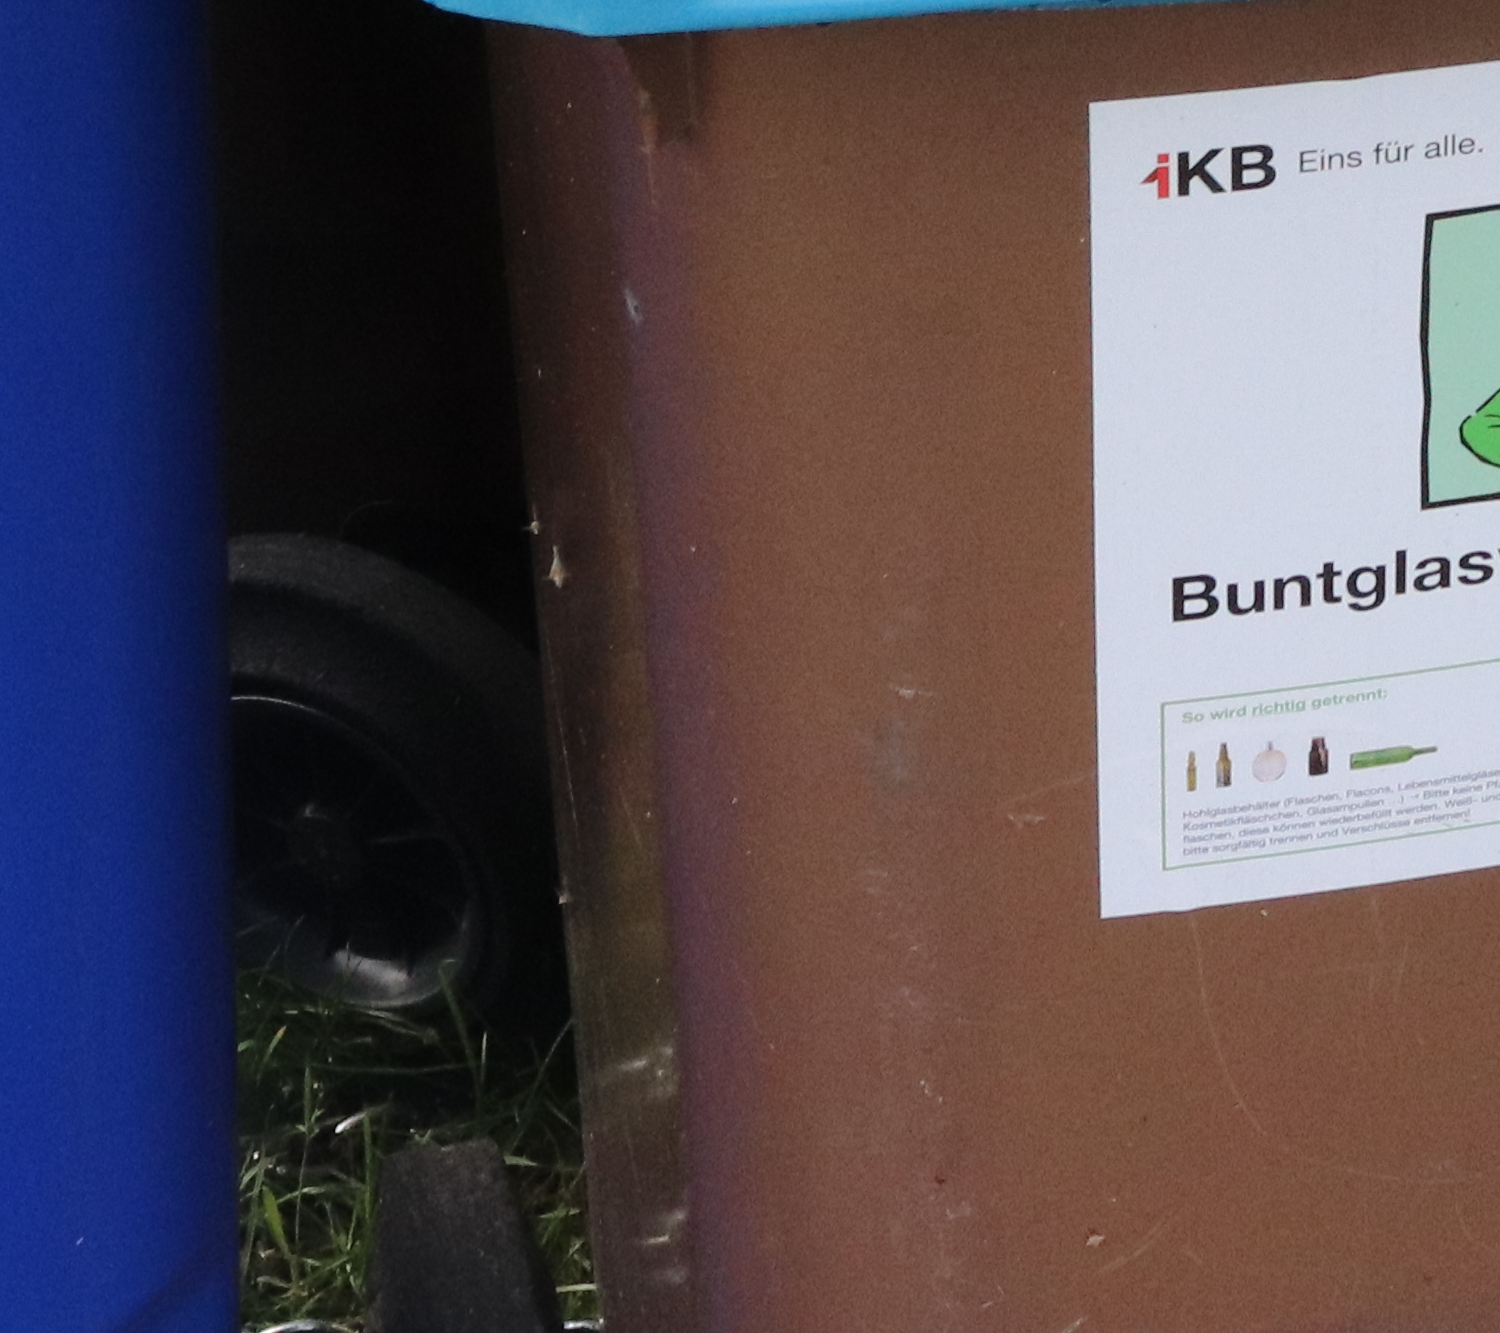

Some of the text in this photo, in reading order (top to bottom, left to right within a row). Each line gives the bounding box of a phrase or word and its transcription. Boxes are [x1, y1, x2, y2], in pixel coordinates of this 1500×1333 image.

[1299, 150, 1362, 173] Eins
[1373, 141, 1415, 165] für
[1424, 134, 1483, 159] alle.
[1182, 688, 1388, 723] So wird richtig getrennt:
[1423, 788, 1450, 800] Bitte
[1452, 784, 1483, 796] keine
[1273, 821, 1315, 833] können
[1183, 846, 1209, 856] bitte
[1270, 834, 1315, 846] trennen
[1317, 828, 1339, 839] und
